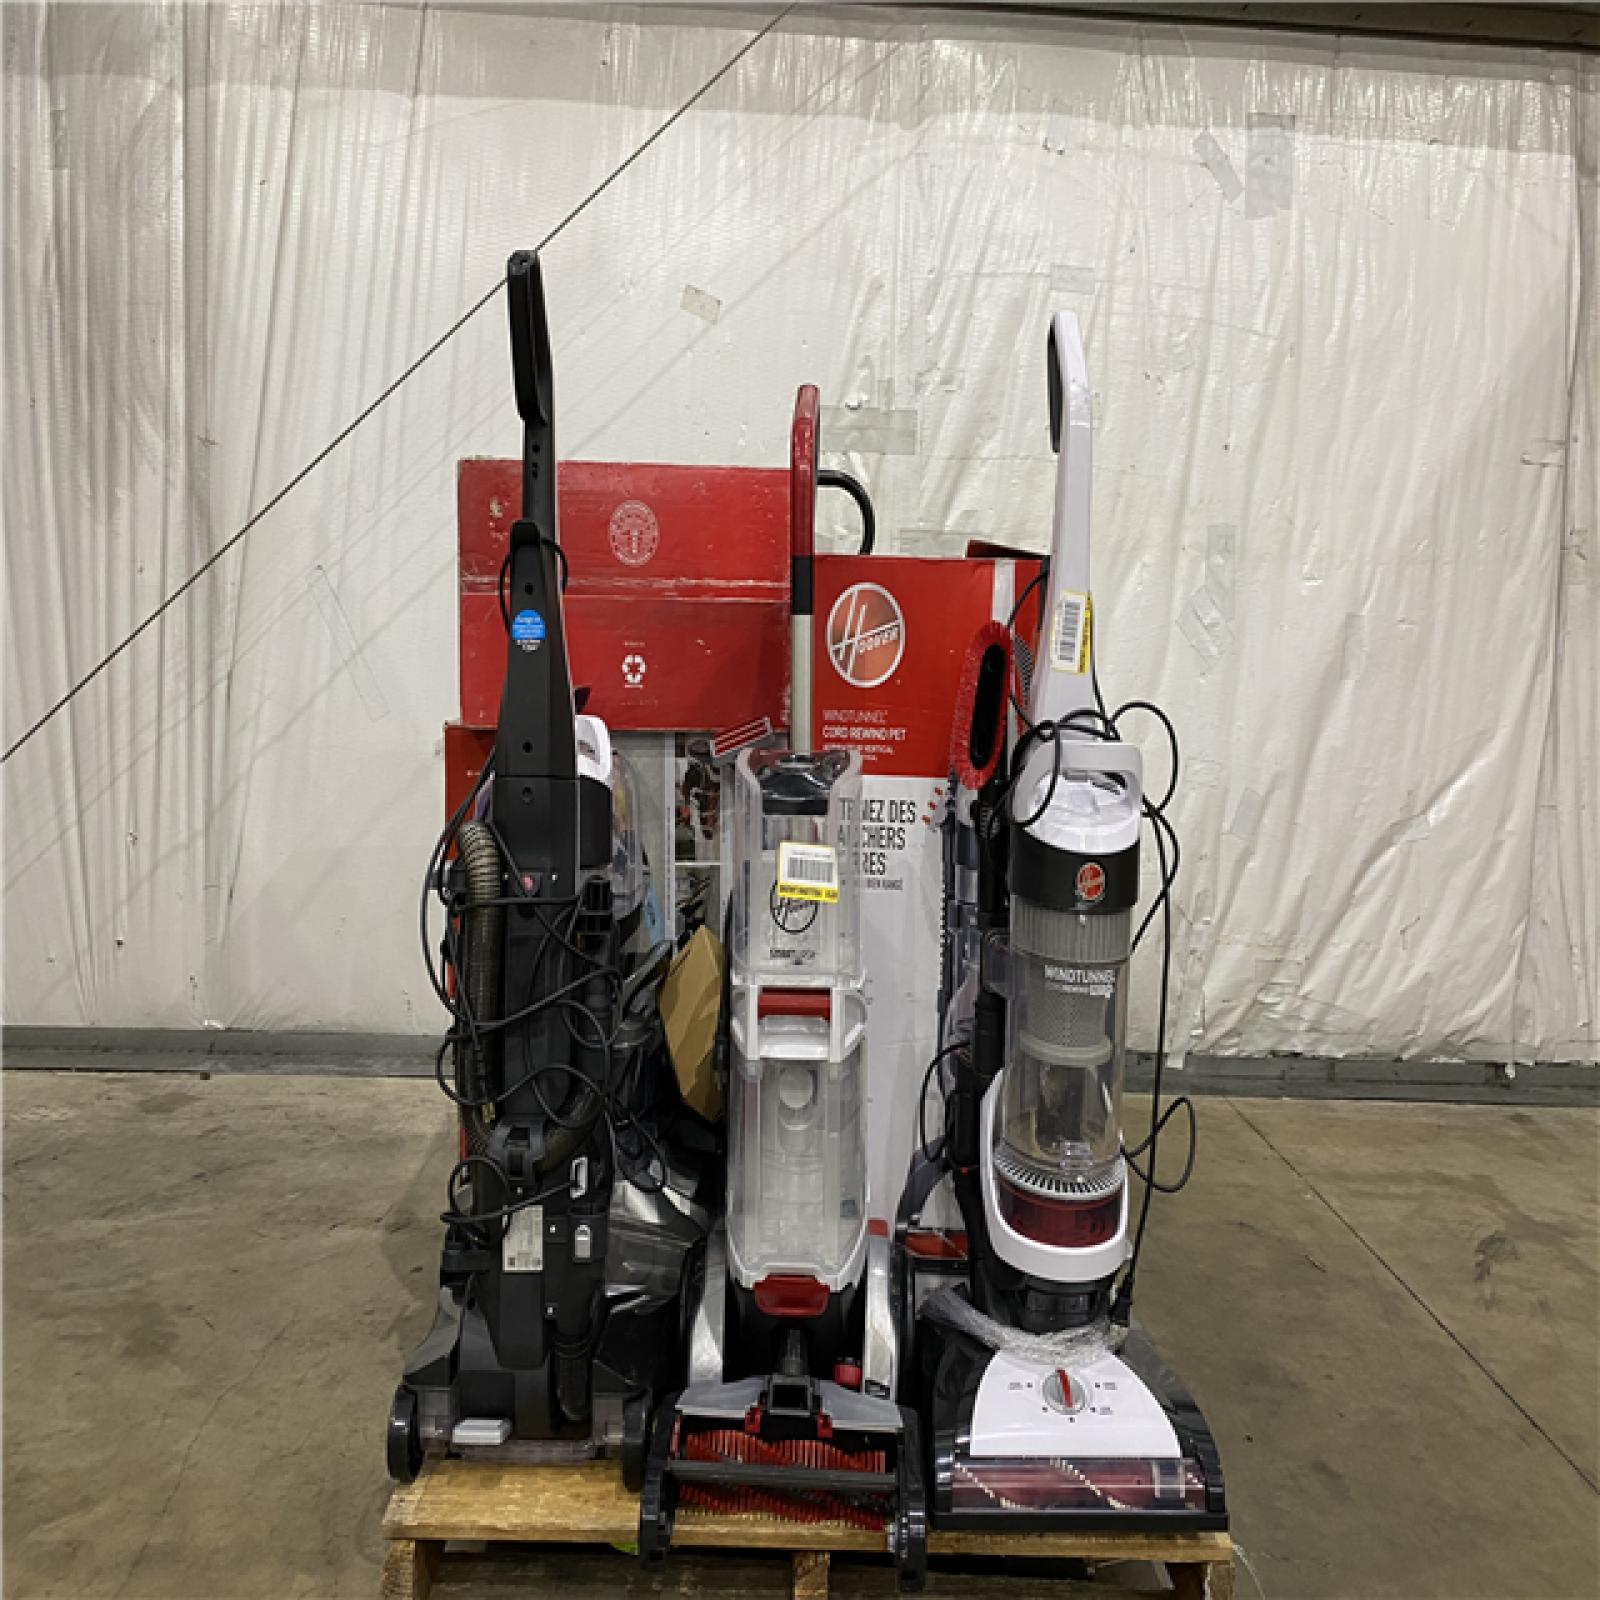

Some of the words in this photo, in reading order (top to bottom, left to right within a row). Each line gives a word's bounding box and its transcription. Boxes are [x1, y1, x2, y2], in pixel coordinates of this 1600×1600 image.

[822, 724, 849, 739] CORD
[850, 726, 886, 741] REWIND
[889, 727, 906, 741] PET
[889, 799, 916, 824] DES
